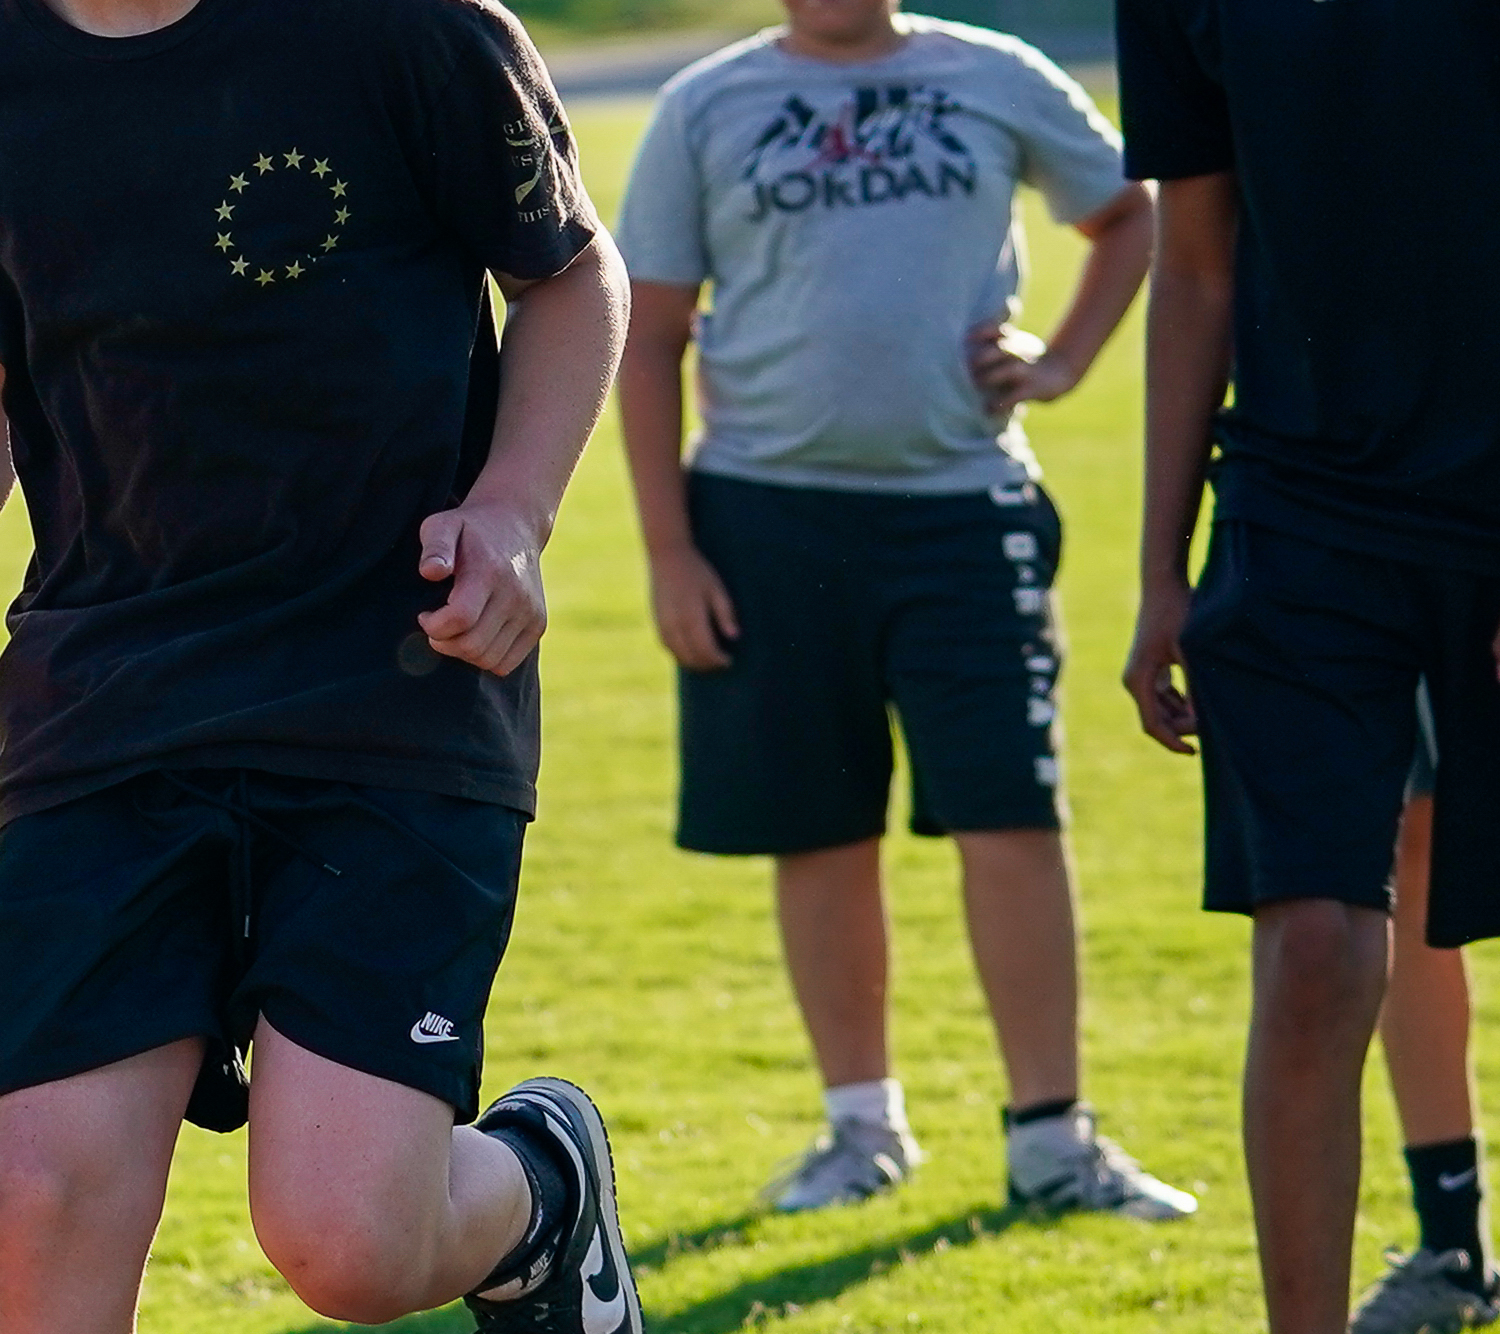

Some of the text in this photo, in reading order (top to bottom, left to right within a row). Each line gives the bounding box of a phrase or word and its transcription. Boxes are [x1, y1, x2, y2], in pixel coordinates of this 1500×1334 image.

[748, 159, 978, 223] JORDAN
[420, 1011, 455, 1036] NIKE
[529, 1251, 550, 1279] NIKE
